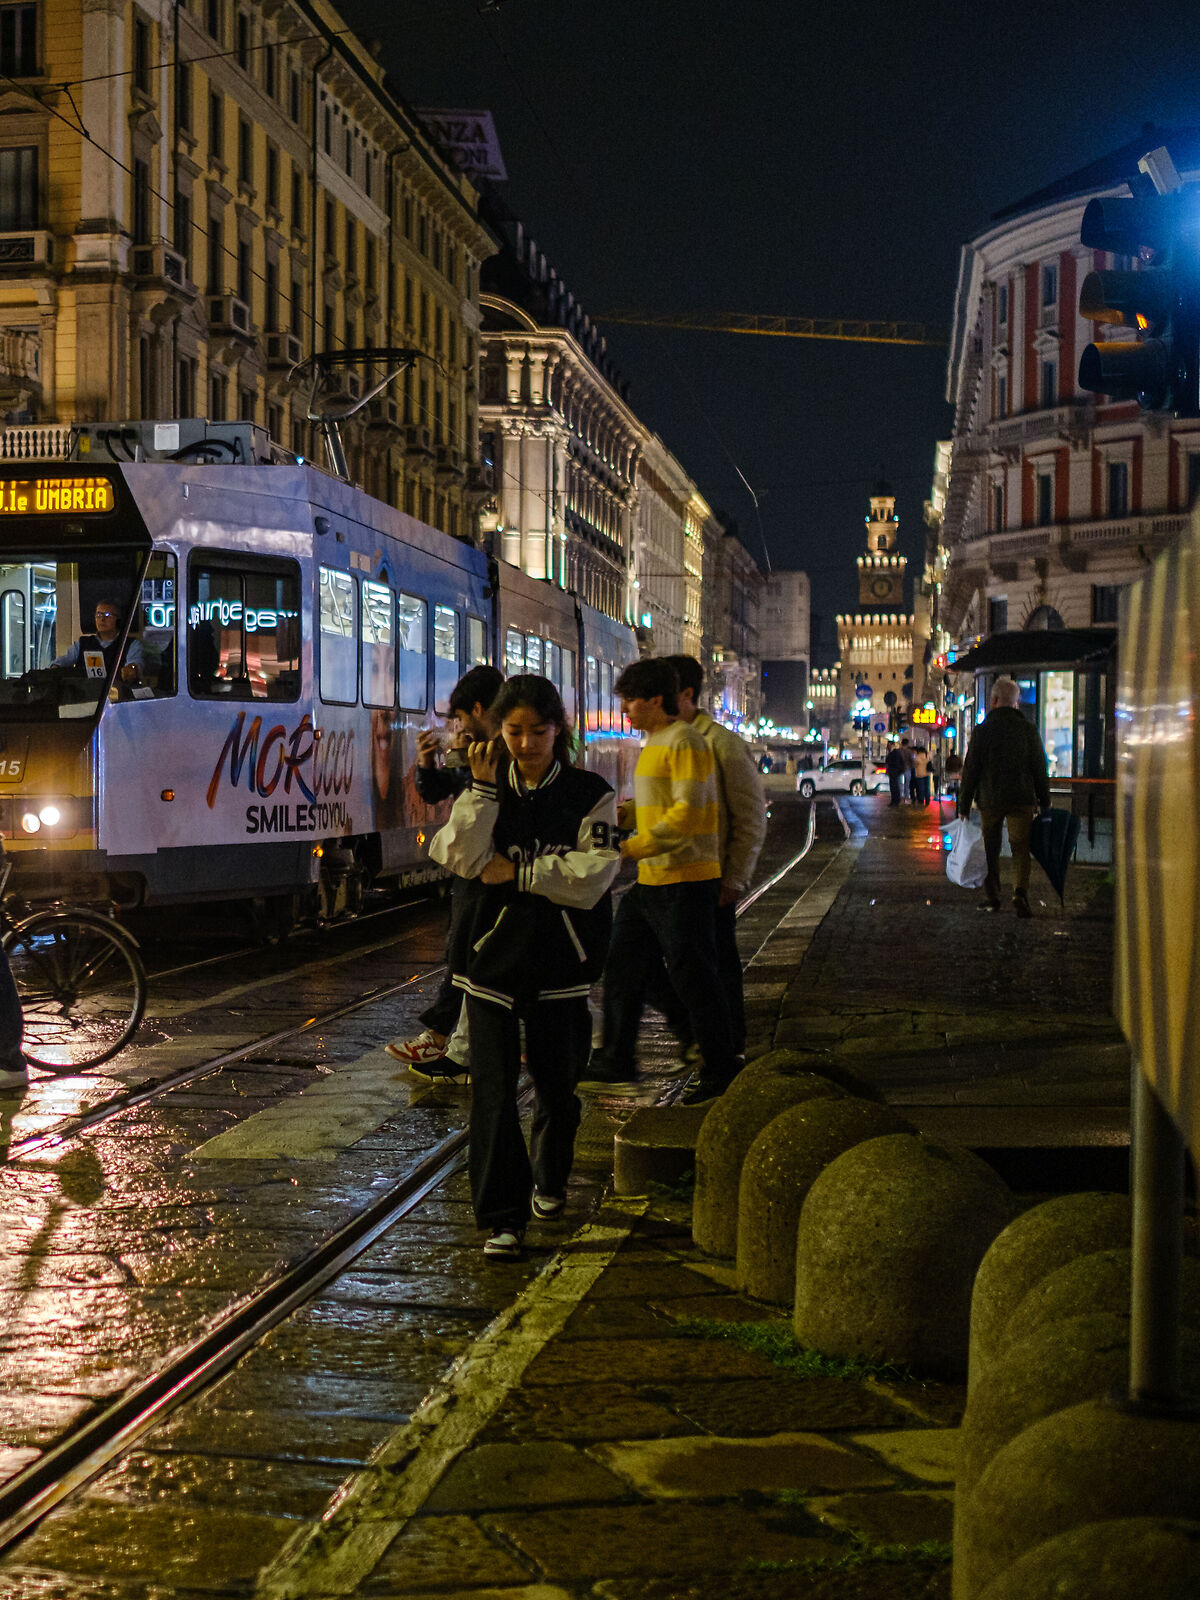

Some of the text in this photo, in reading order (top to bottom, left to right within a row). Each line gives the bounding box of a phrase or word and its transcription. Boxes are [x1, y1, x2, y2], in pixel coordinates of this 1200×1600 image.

[36, 487, 107, 511] UMBRIA
[91, 656, 97, 667] 7
[91, 667, 103, 677] 16
[246, 804, 316, 834] SMILES
[316, 803, 329, 830] TO
